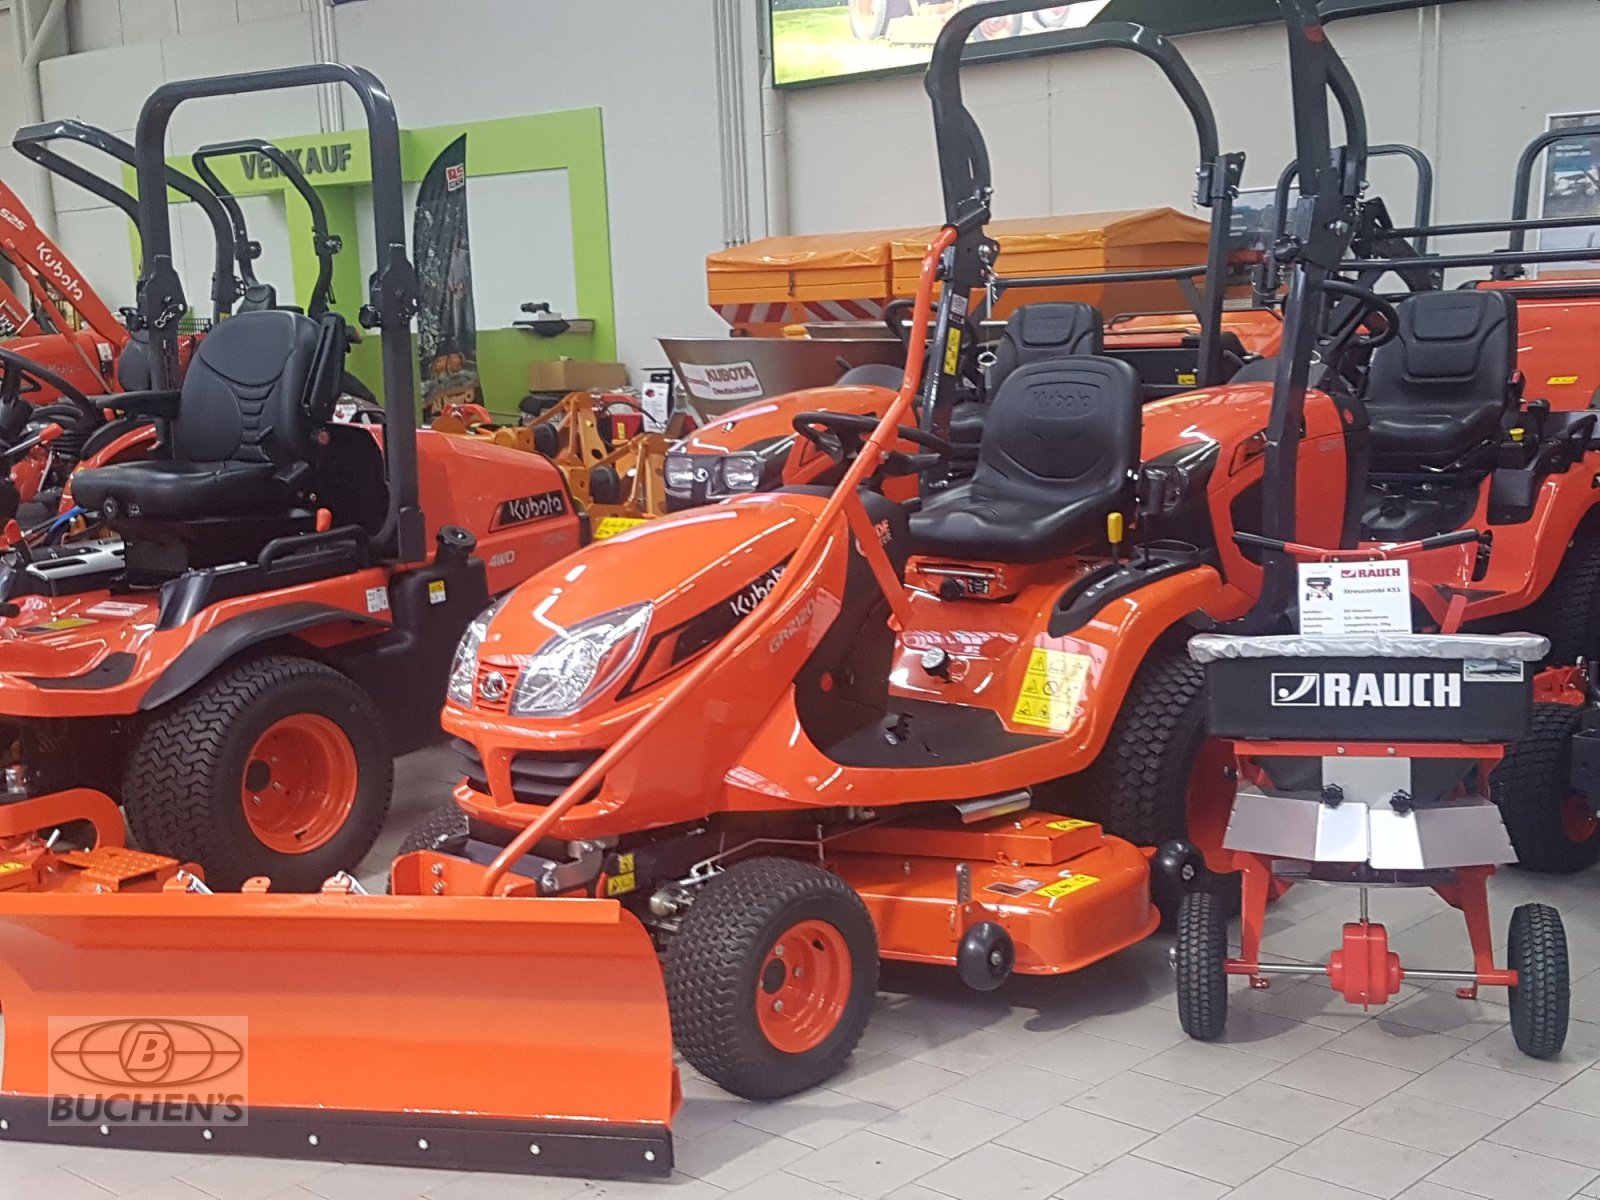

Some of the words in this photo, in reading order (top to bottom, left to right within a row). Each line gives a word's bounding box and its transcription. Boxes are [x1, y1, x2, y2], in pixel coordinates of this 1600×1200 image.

[36, 241, 83, 301] Kubota
[705, 365, 755, 382] KUBOTA
[509, 493, 562, 520] Kubota
[488, 550, 515, 567] 4WD
[1358, 567, 1401, 578] RAUCH
[1323, 672, 1461, 707] RAUCH
